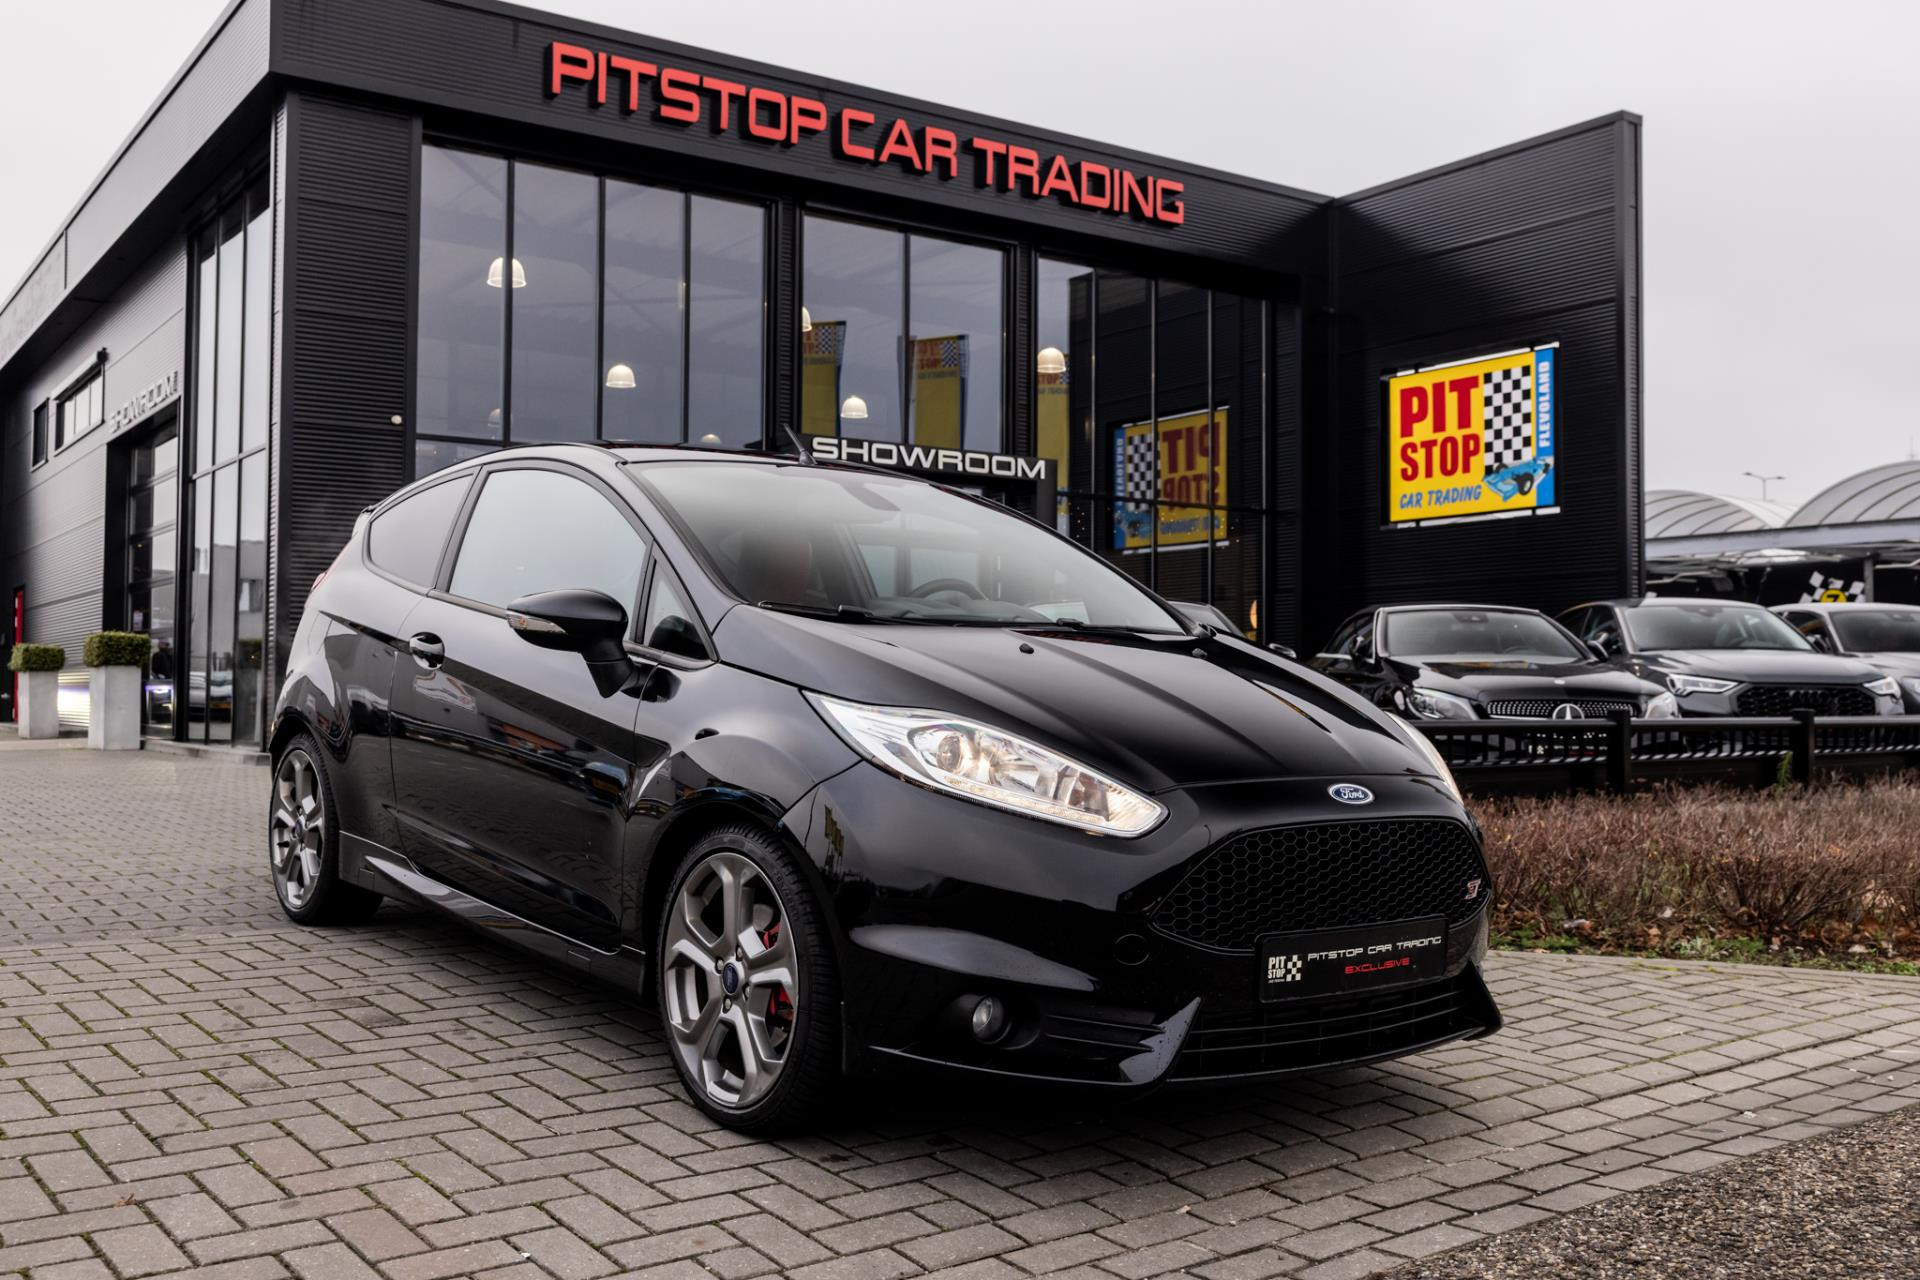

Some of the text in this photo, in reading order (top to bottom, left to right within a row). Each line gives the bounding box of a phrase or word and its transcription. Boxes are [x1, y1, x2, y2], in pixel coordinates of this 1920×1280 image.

[552, 41, 1185, 225] PITSTOP CAR TRADING
[1400, 375, 1480, 438] PIT
[1538, 360, 1551, 448] FLEVOLAND
[812, 437, 1046, 480] SHOWROOM
[1400, 433, 1481, 482] STOP
[1400, 484, 1482, 509] CAR TRADING
[1268, 956, 1286, 970] PIT
[1307, 936, 1442, 962] PITSTOP CAR TRADING
[1344, 957, 1410, 974] EXCLUSIVE
[1267, 968, 1286, 979] STOP
